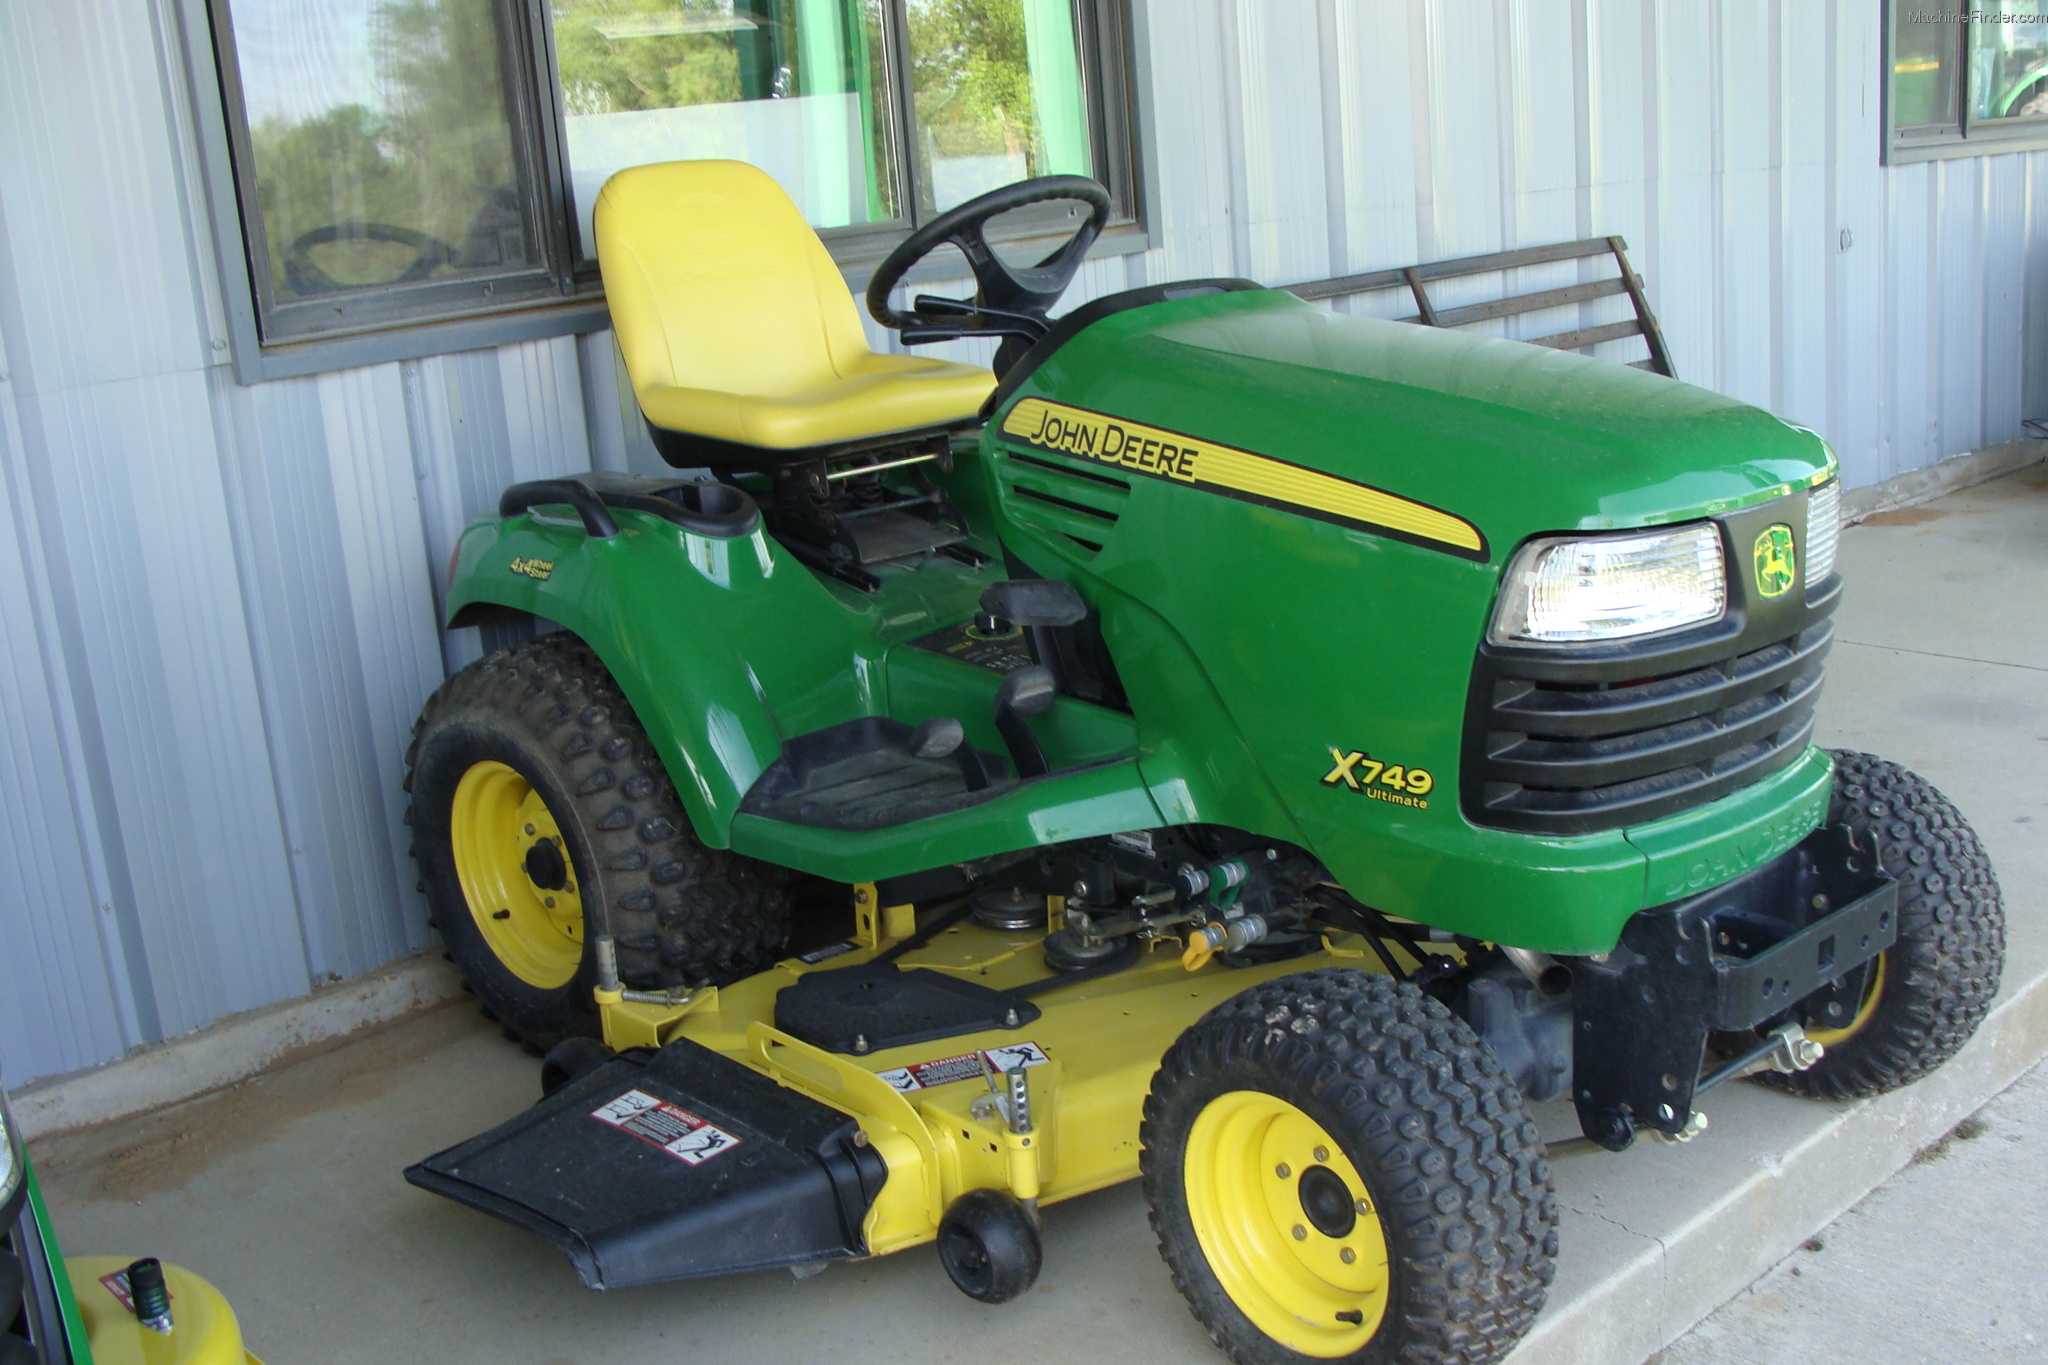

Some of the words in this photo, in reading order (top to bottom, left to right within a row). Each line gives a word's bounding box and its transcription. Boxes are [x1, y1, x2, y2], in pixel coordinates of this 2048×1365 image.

[1030, 410, 1098, 453] JOHN
[1101, 424, 1199, 477] DEERE
[1322, 746, 1433, 795] X749
[1366, 787, 1429, 809] Ultimate
